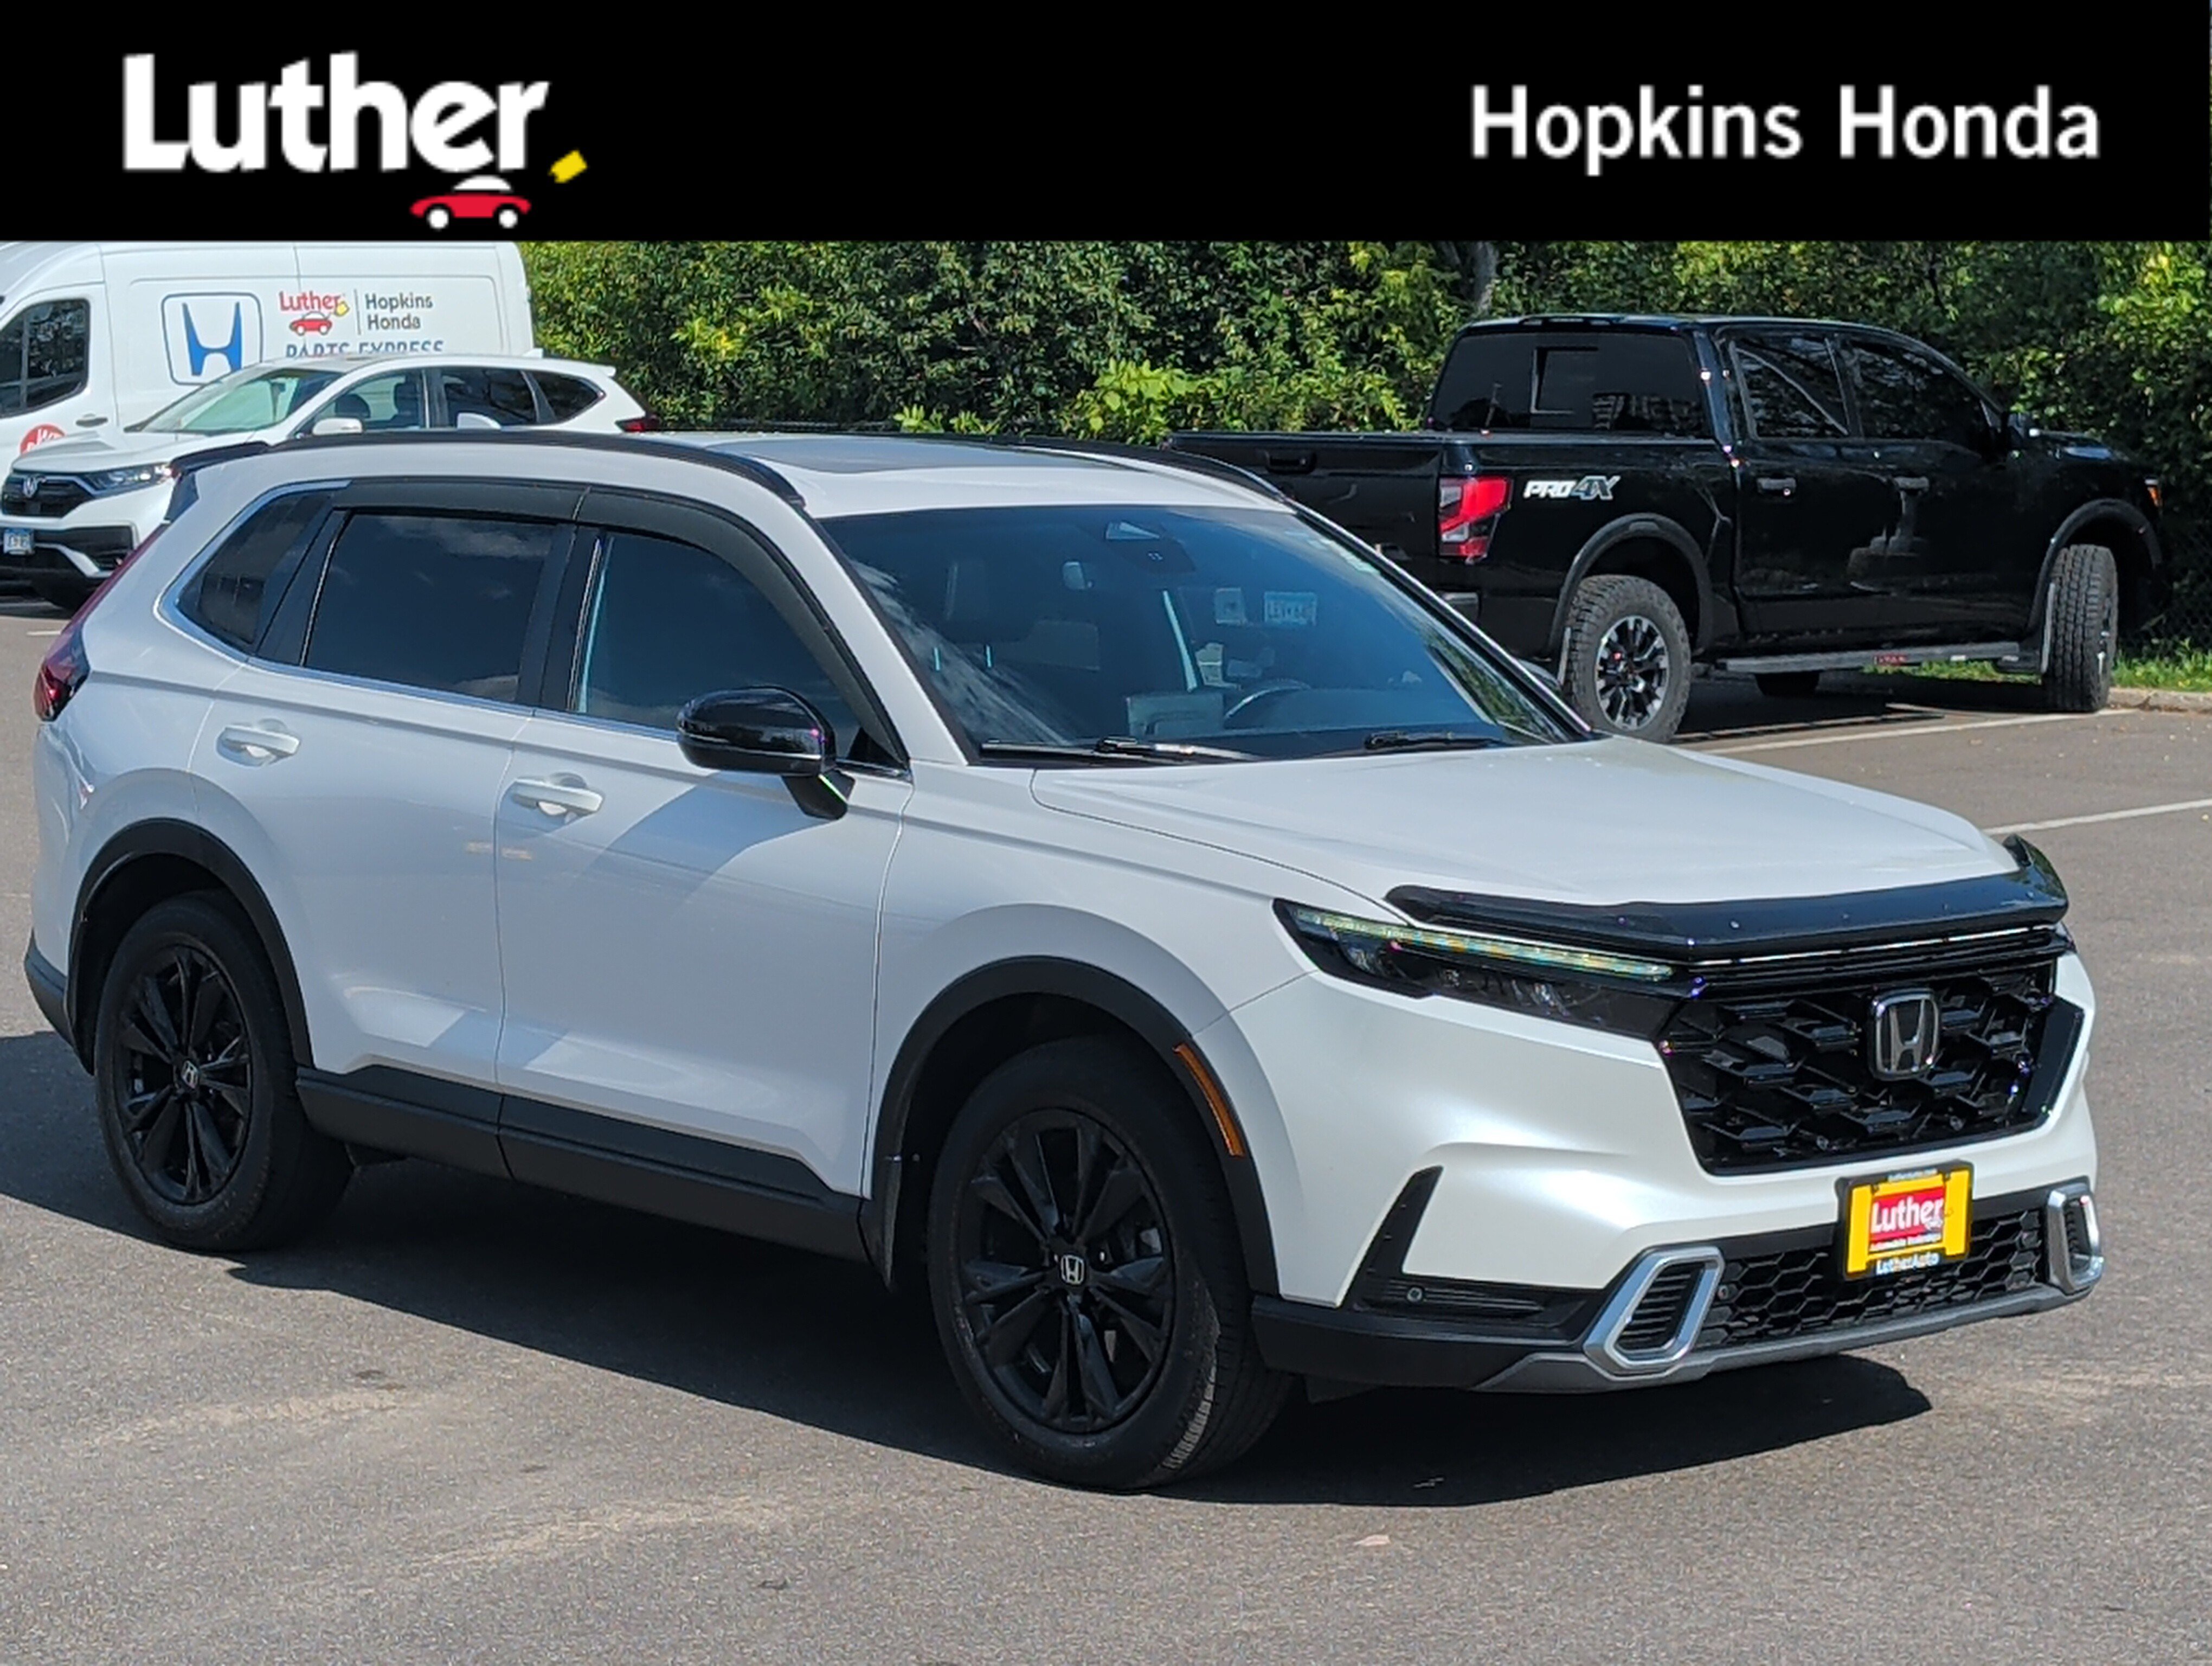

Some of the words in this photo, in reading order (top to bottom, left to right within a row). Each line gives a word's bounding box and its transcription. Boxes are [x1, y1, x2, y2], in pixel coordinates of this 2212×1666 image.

[279, 291, 341, 311] Luther
[364, 292, 433, 313] Hopkins
[367, 313, 421, 330] Honda
[1871, 1195, 1944, 1234] Luther
